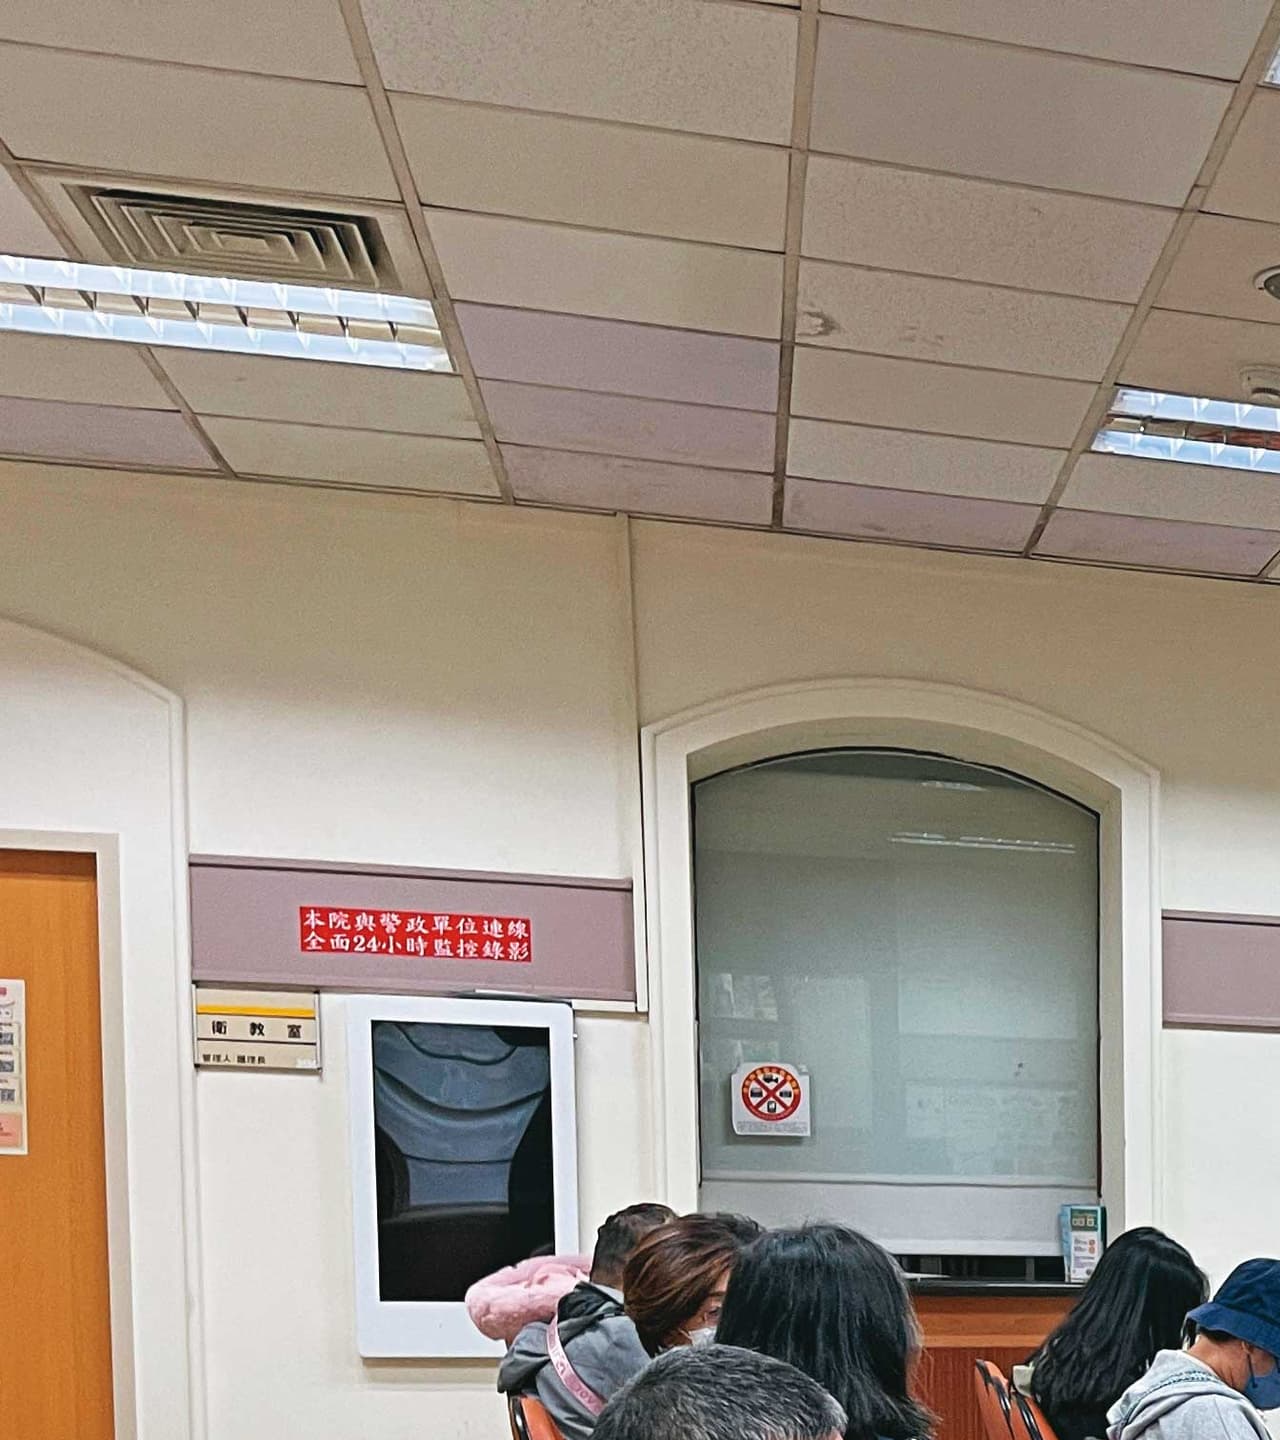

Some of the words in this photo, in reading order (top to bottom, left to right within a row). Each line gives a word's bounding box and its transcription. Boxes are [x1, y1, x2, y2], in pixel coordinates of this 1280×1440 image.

[303, 909, 529, 939] 本院與警政單位連線
[303, 931, 529, 961] 全面24小時監控錄影
[211, 1020, 302, 1039] 衛教室
